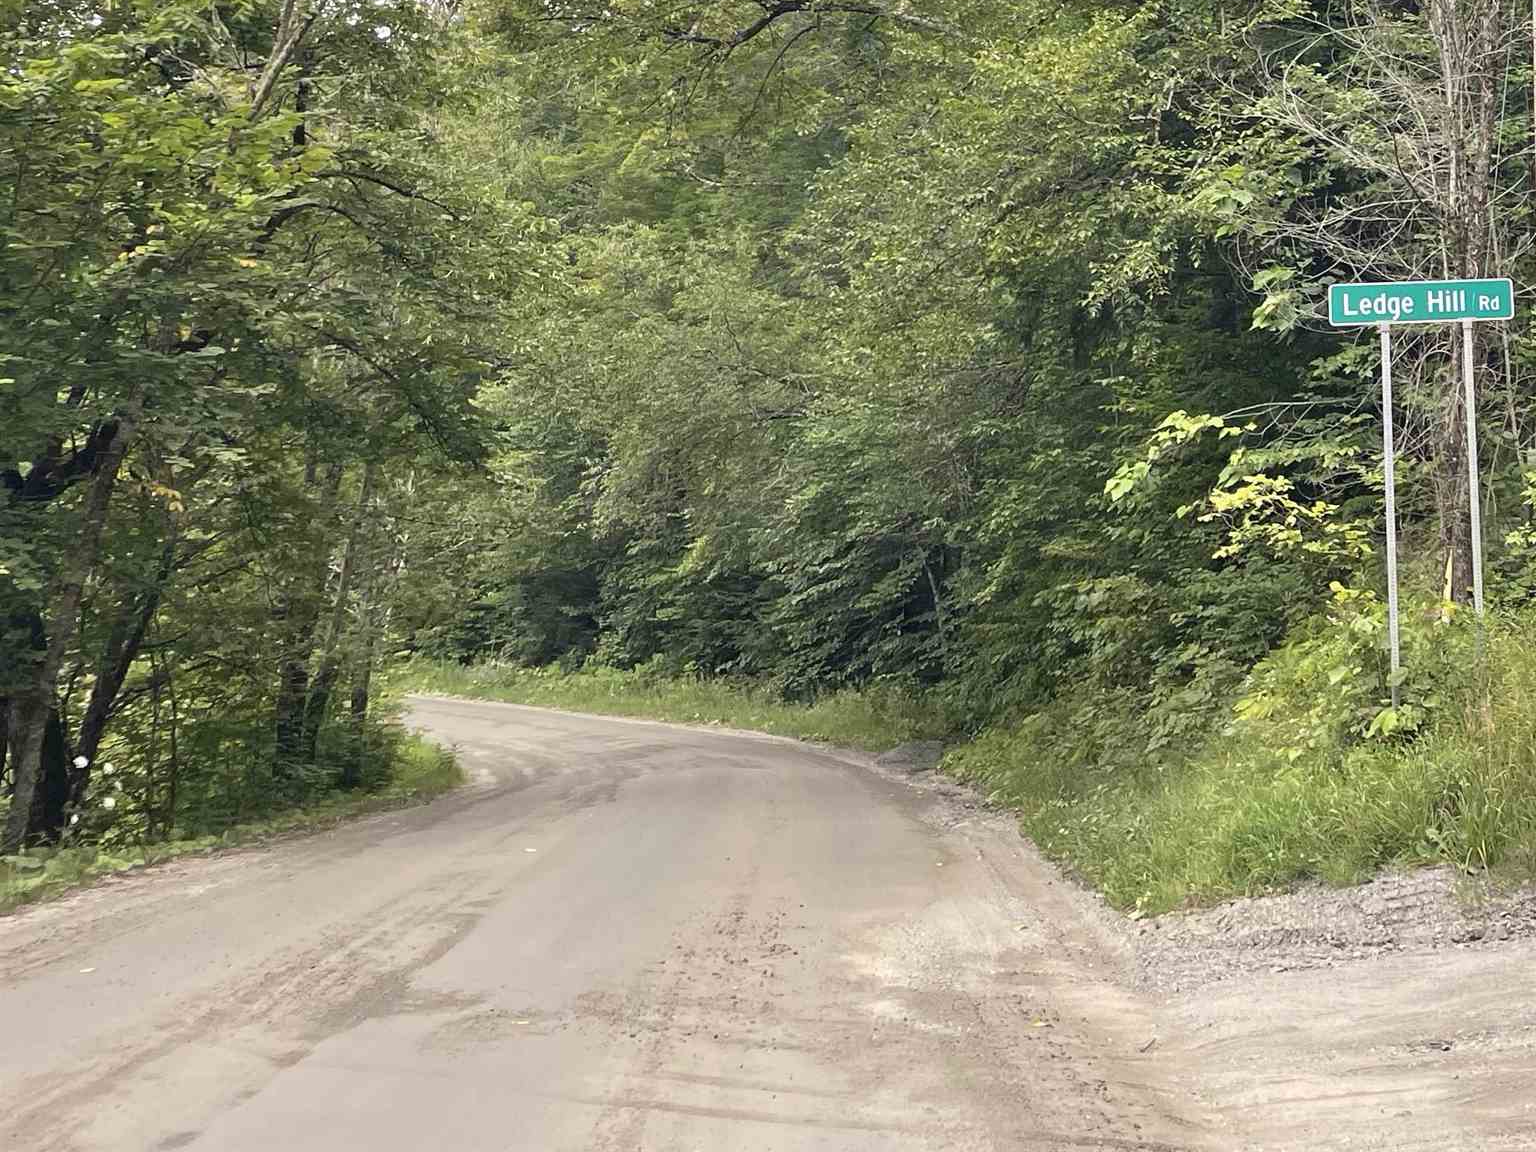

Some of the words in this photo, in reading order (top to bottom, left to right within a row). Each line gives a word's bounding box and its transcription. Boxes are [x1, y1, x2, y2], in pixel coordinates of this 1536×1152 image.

[1342, 292, 1415, 320] Ledge
[1427, 289, 1467, 313] Hill
[1478, 295, 1501, 311] Rd
